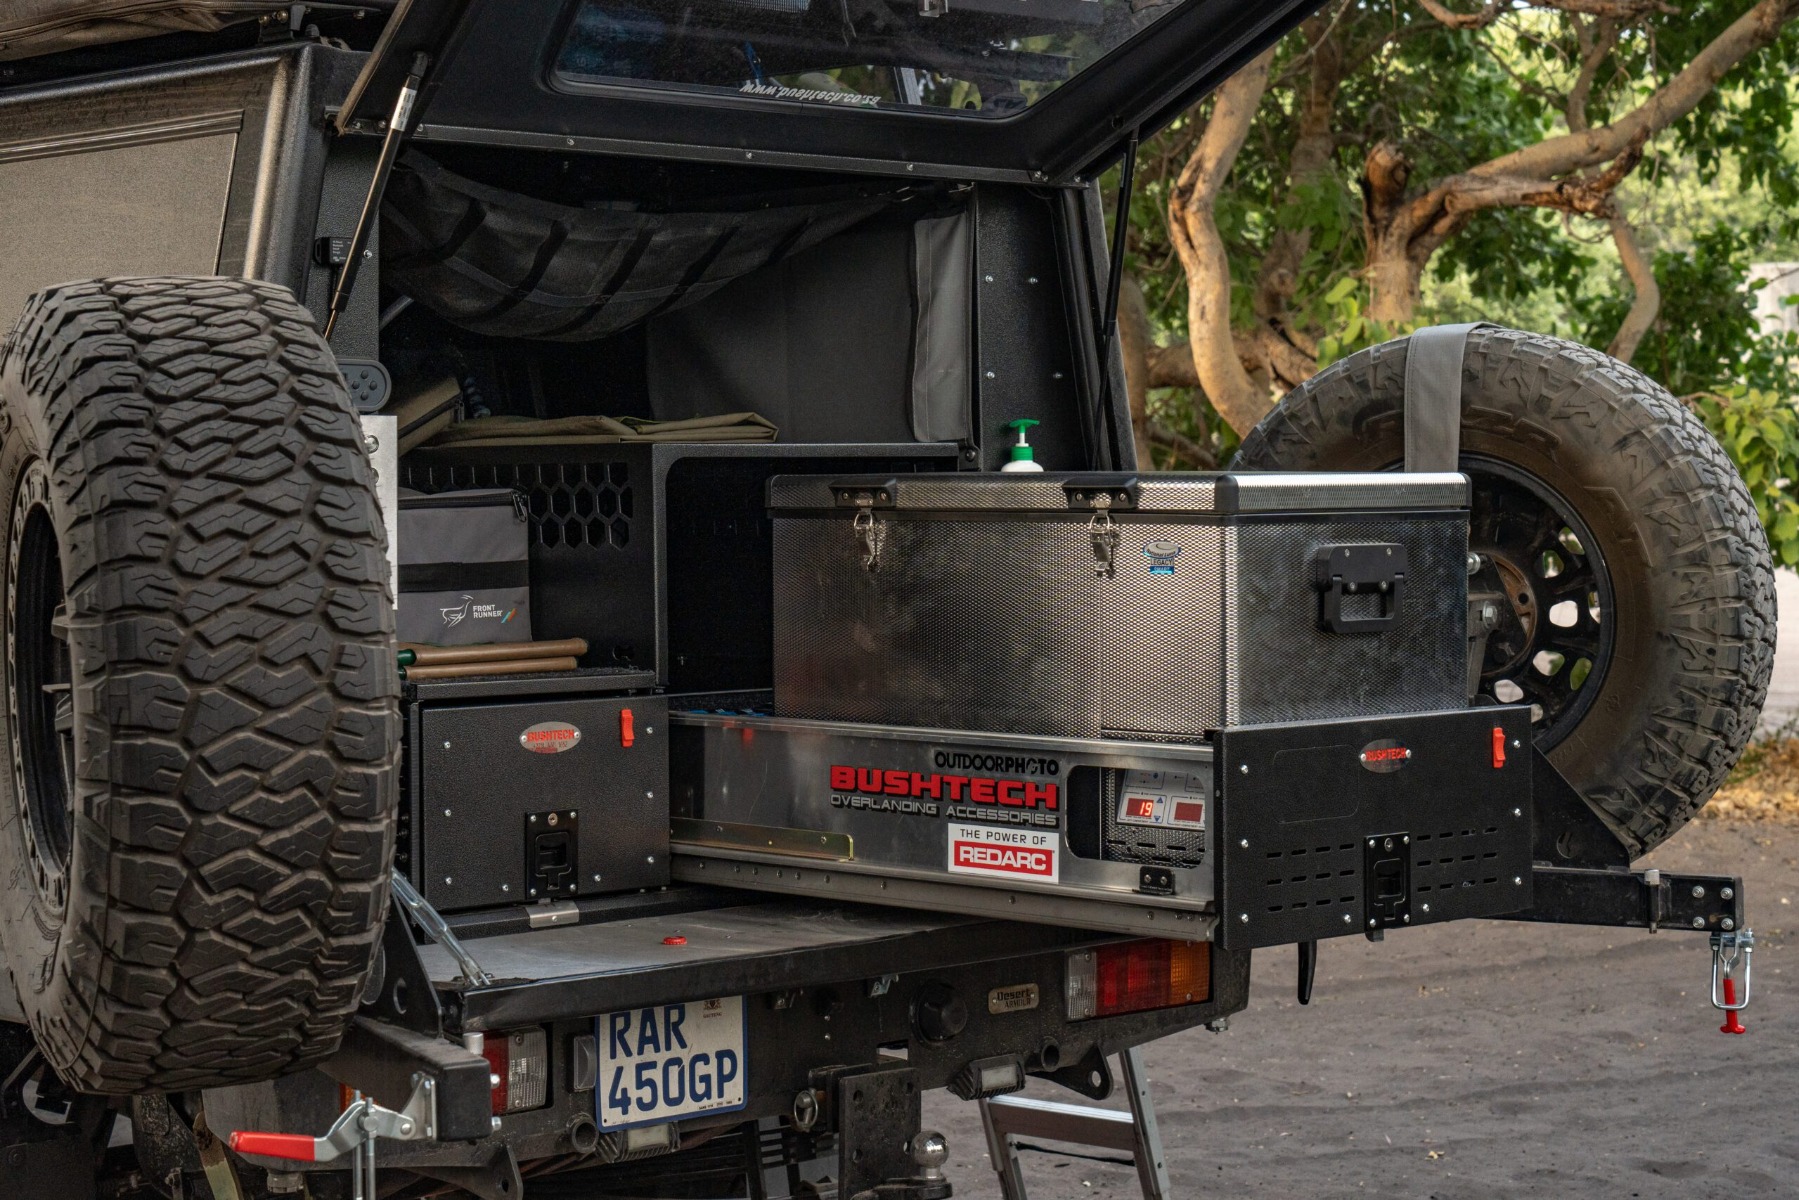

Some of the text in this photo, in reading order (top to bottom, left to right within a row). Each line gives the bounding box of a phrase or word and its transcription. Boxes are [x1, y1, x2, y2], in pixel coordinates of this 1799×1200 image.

[472, 604, 496, 612] FRONT
[473, 610, 502, 619] RUNNER
[527, 729, 575, 742] BUSHTECH
[830, 765, 1059, 811] BUSHTECH
[830, 794, 1058, 828] OVERLANDING ACCESSORIES
[1139, 801, 1153, 817] 19
[960, 828, 1047, 845] THE POWER OF
[959, 845, 1047, 871] REDARC
[997, 988, 1030, 1001] Desert
[609, 1003, 688, 1060] RAR
[608, 1048, 738, 1116] 450GP
